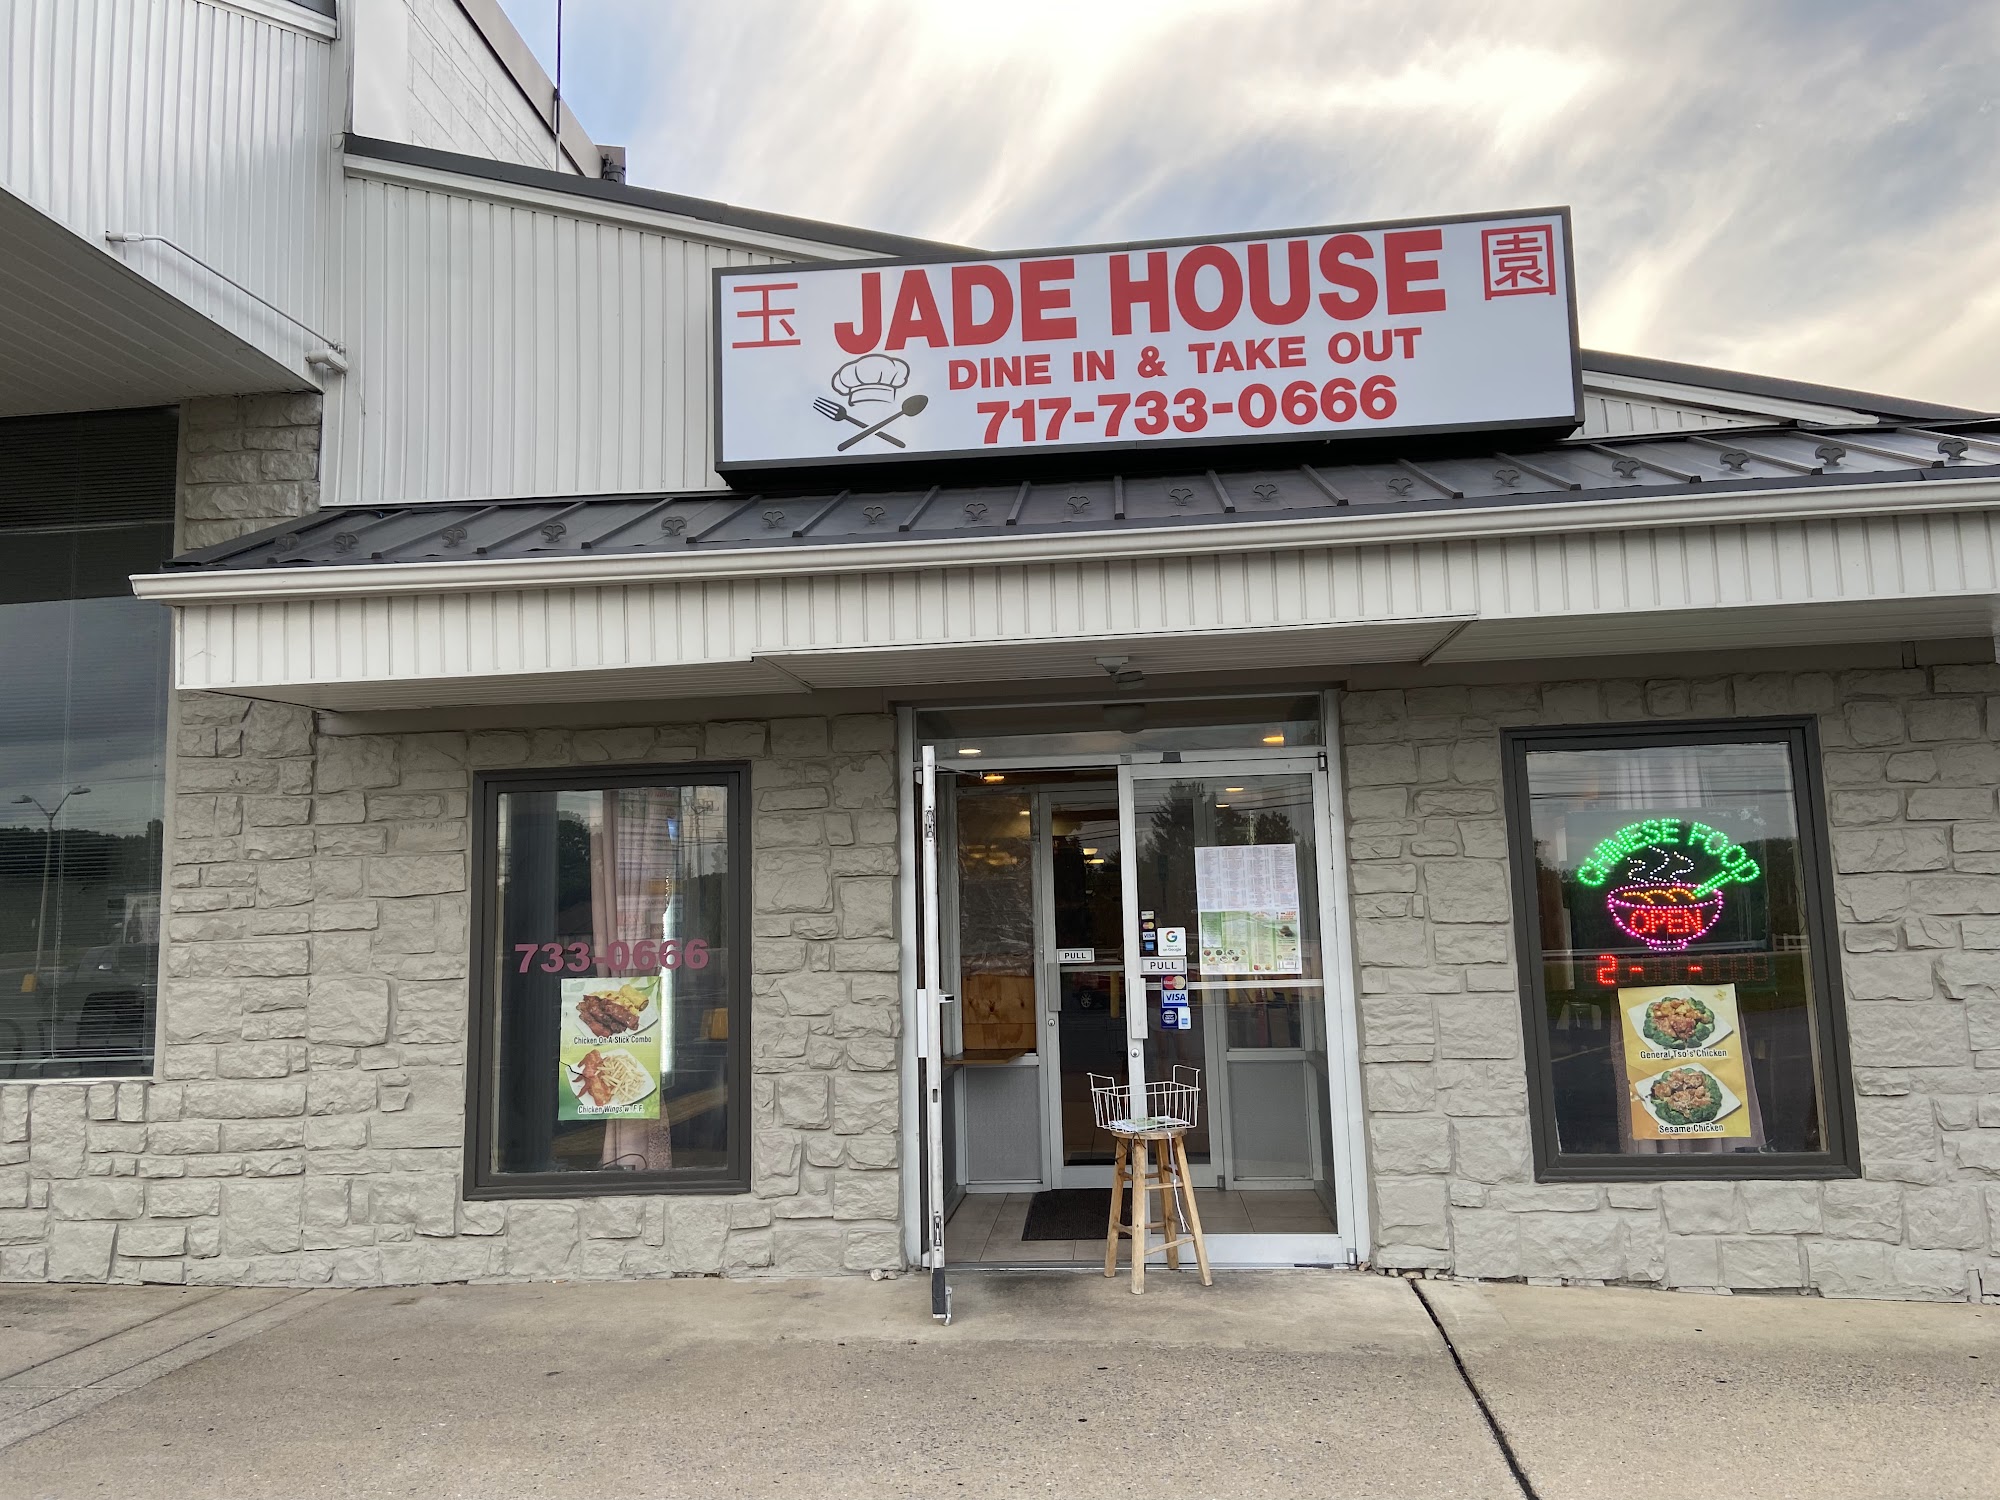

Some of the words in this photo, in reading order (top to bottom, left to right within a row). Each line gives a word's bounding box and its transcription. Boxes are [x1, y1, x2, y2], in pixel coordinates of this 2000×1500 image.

[1481, 224, 1556, 301] 園
[834, 258, 1077, 355] JADE
[1109, 229, 1446, 336] HOUSE
[732, 283, 801, 349] 玉
[949, 356, 1052, 391] DINE
[1073, 349, 1115, 384] IN
[1137, 346, 1167, 379] &
[1188, 336, 1307, 374] TAKE
[1328, 327, 1422, 365] OUT
[977, 375, 1397, 444] 717-733-0666
[1577, 817, 1681, 887] CHINESE
[1687, 821, 1761, 883] FOOD
[1630, 908, 1703, 934] OPEN
[514, 938, 709, 974] 733-0666
[1150, 961, 1177, 970] PULL
[1165, 993, 1186, 1001] VISA
[574, 1036, 597, 1044] Chicken
[631, 1035, 652, 1043] Combo
[1640, 1050, 1671, 1059] General
[1696, 1049, 1727, 1057] Chicken
[578, 1105, 602, 1114] Chicken
[604, 1105, 623, 1114] Wings
[1659, 1124, 1691, 1134] Sesame
[1693, 1123, 1724, 1133] Chicken
